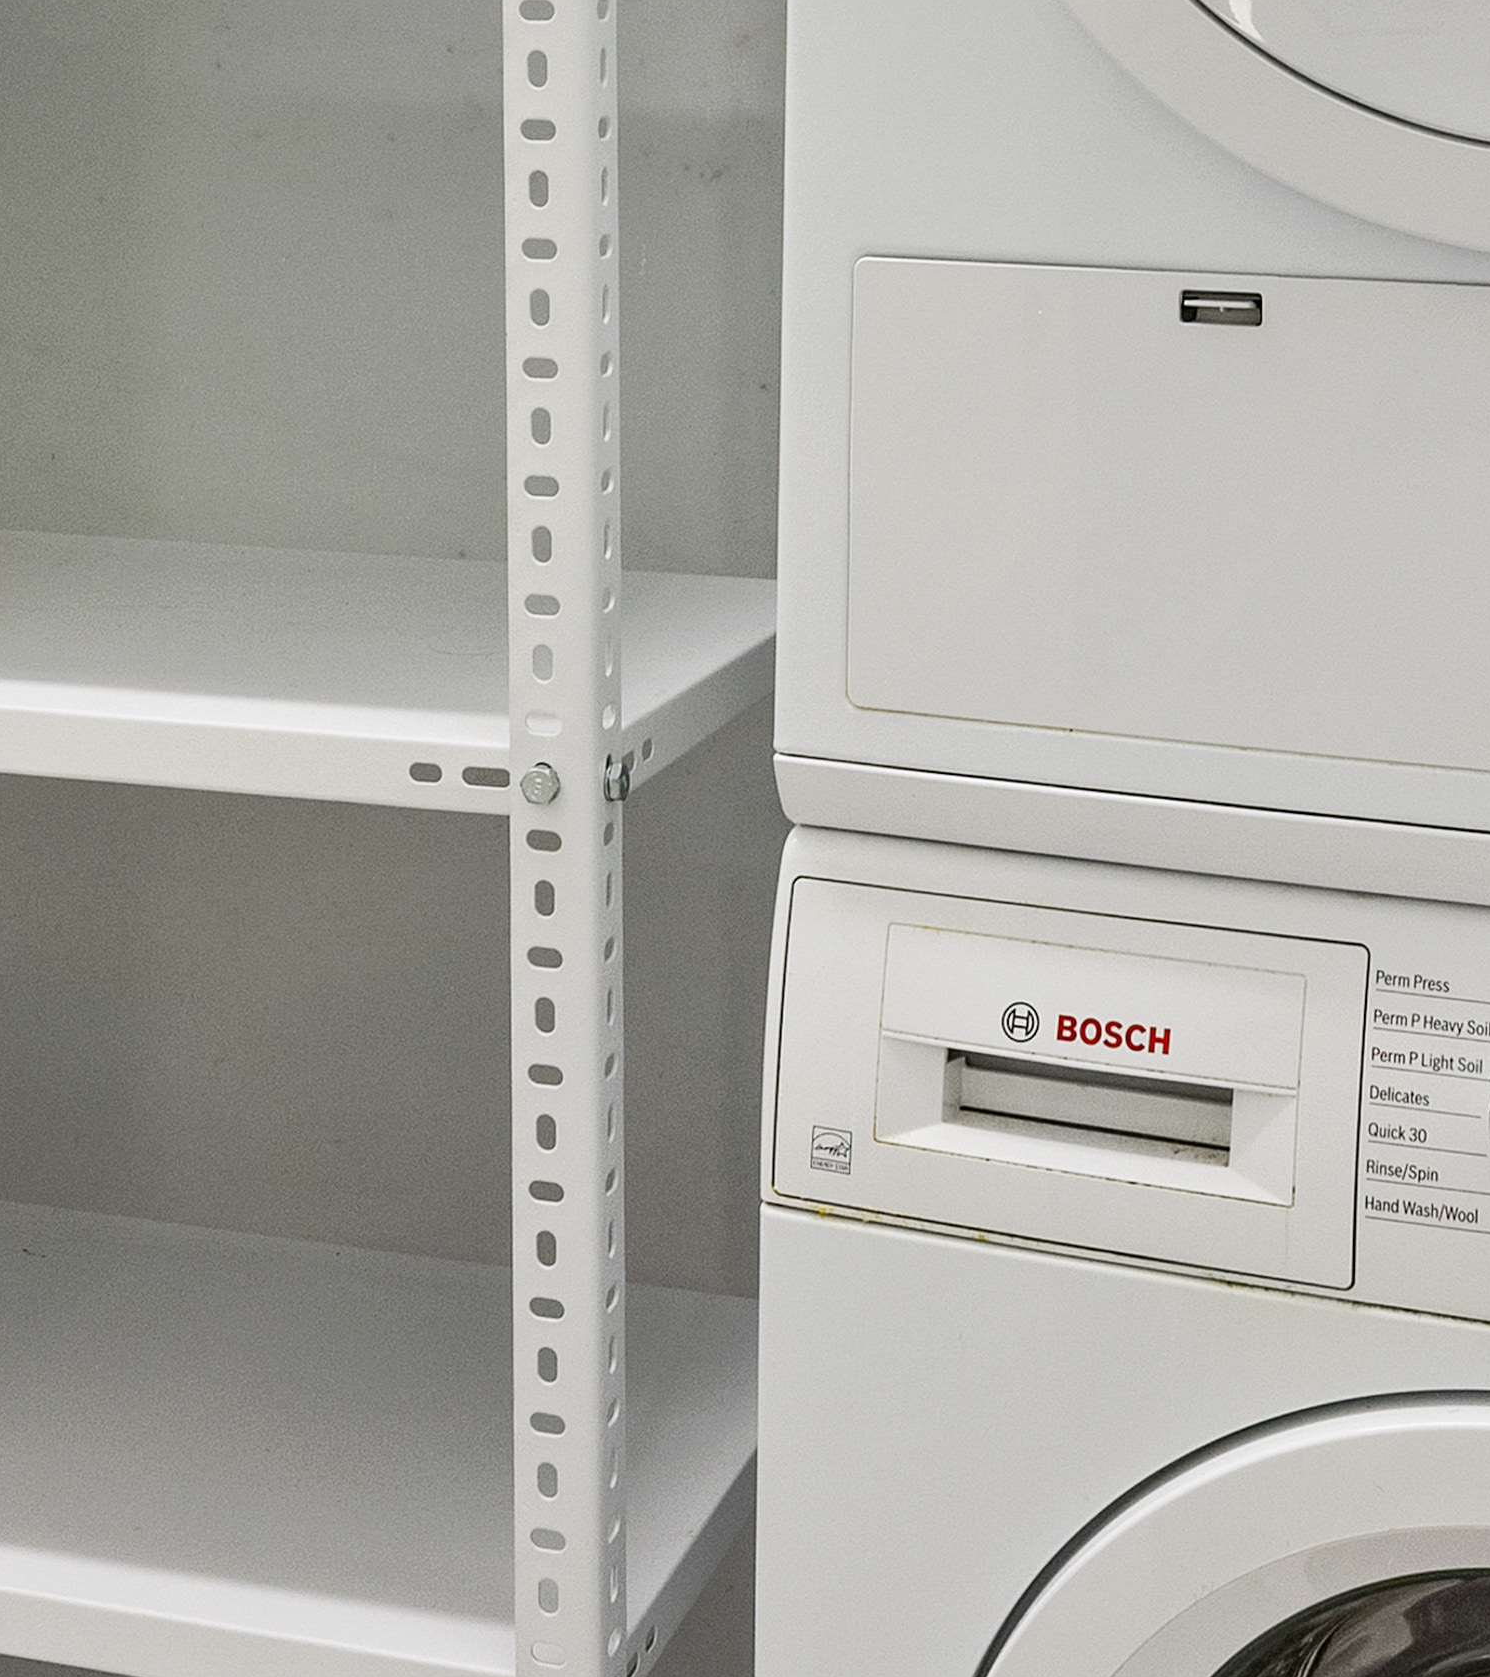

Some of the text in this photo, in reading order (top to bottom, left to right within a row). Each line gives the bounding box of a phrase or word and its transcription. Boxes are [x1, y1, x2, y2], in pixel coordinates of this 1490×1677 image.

[1376, 970, 1450, 993] Perm Press
[1056, 1015, 1171, 1054] BOSCH
[1373, 1010, 1408, 1026] Perm
[1411, 1014, 1420, 1027] P
[1424, 1015, 1463, 1035] Heavy
[1371, 1048, 1483, 1073] Perm P Light Soil
[1370, 1085, 1429, 1106] Delicates
[1368, 1123, 1426, 1142] Quick 30
[1366, 1159, 1438, 1182] Rinse/Spin
[1365, 1196, 1478, 1223] Hand Wash/Wool
